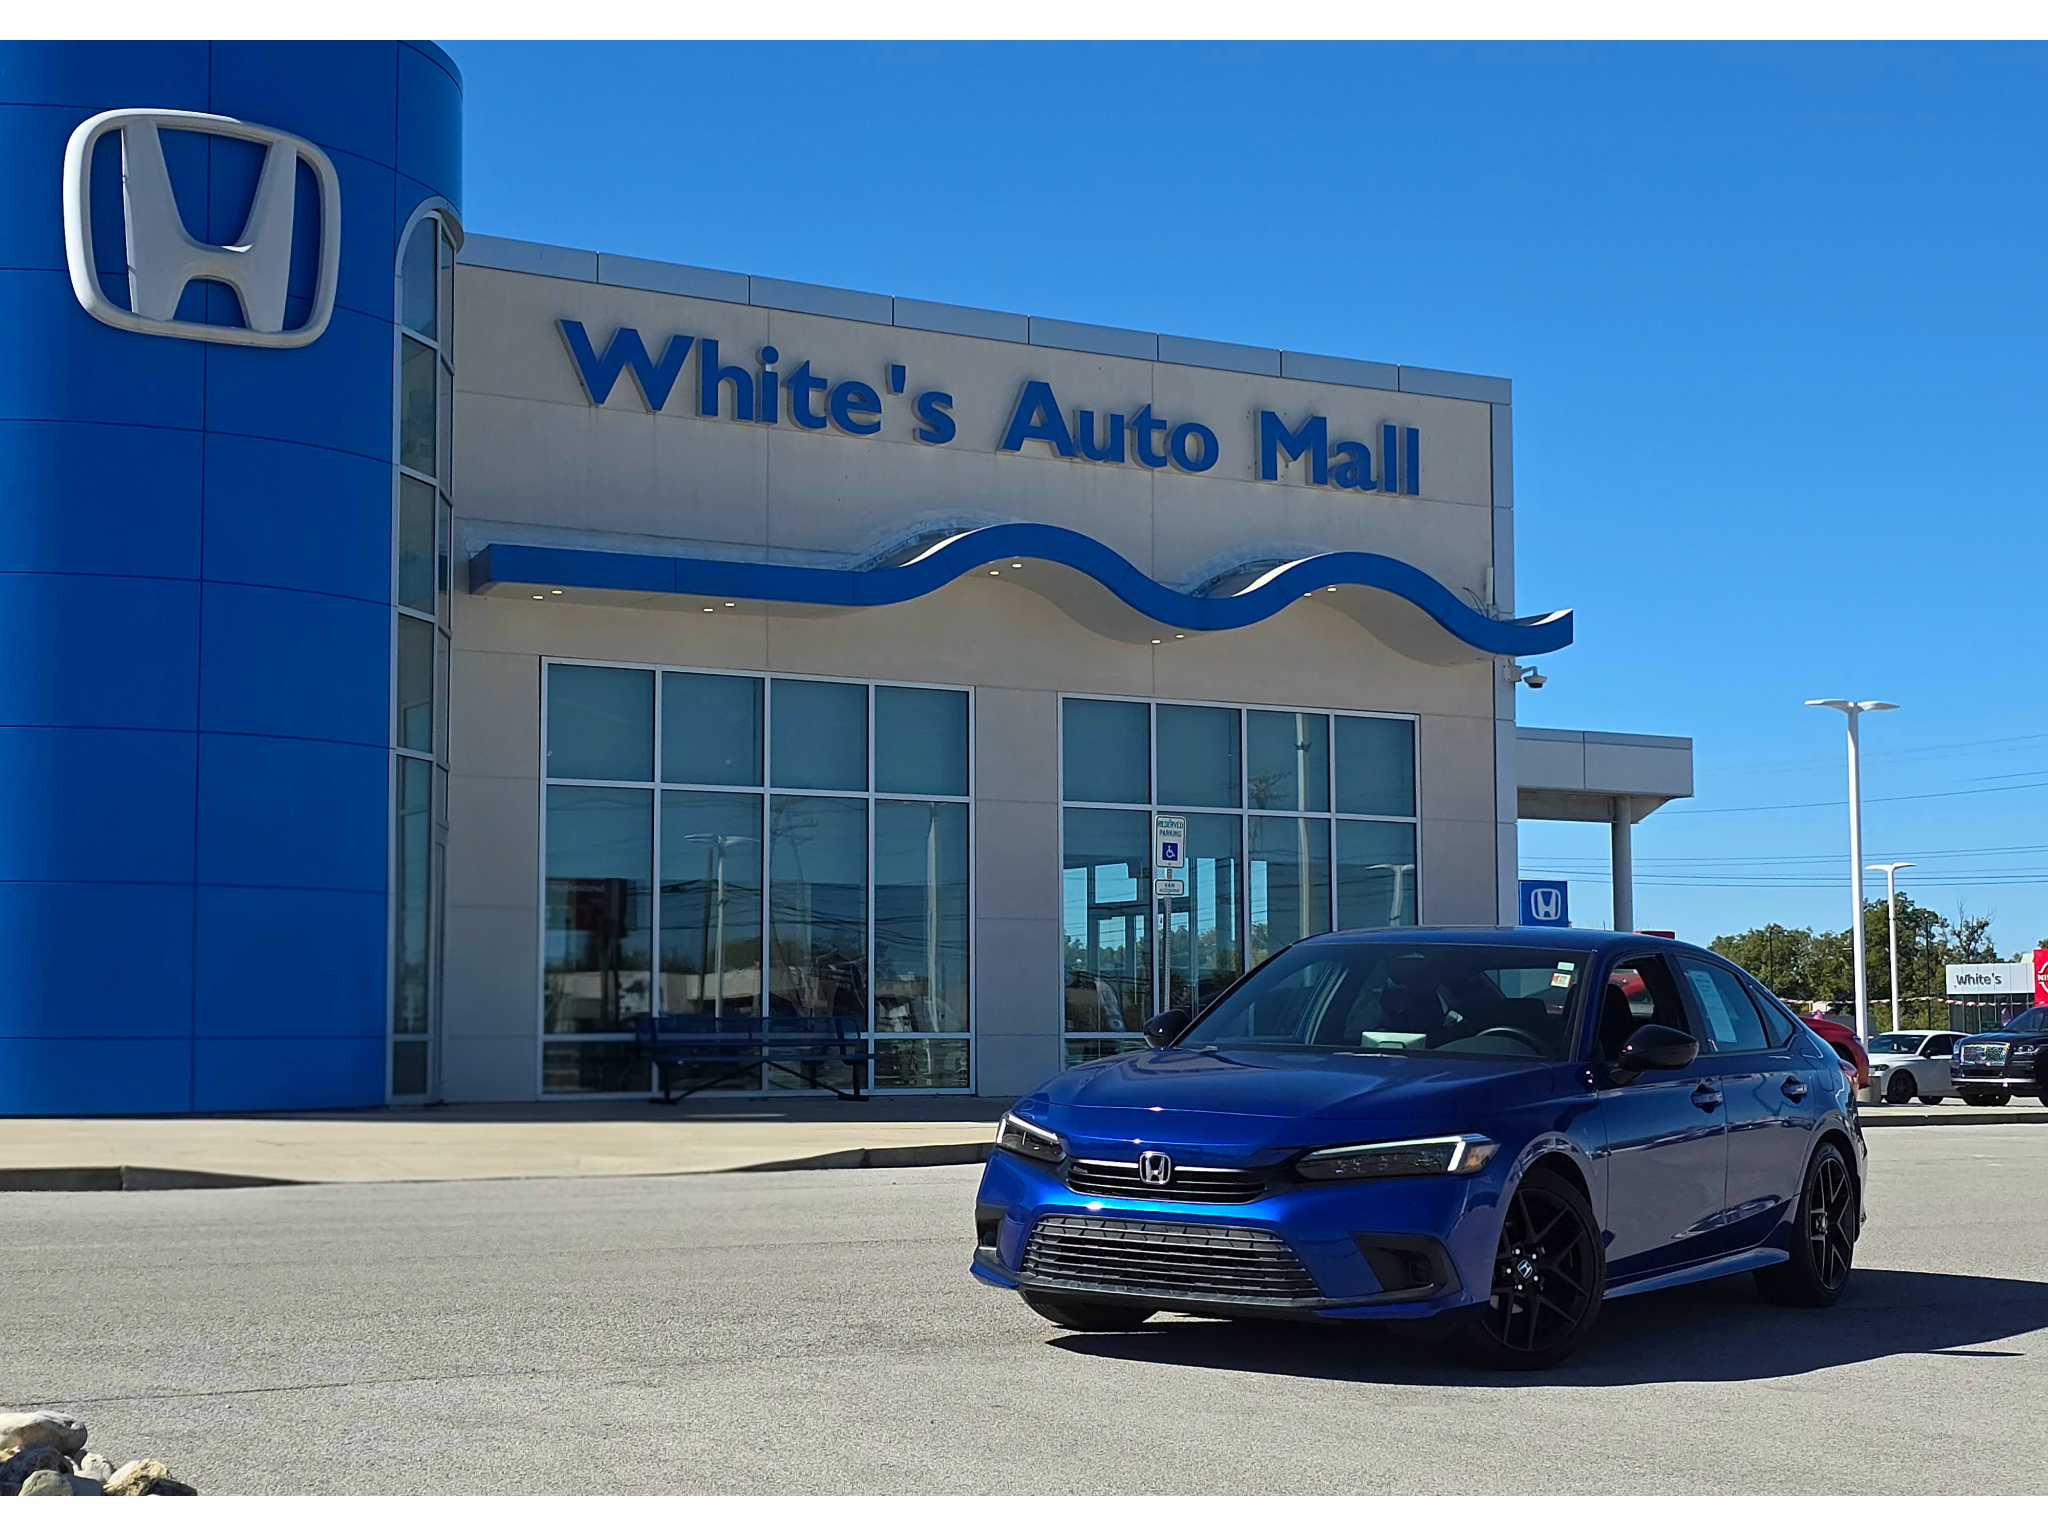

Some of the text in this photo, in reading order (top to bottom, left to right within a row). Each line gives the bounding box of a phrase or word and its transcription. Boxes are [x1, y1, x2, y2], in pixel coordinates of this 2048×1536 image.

[556, 319, 1420, 496] White's Auto Mall
[1158, 821, 1183, 829] RESERVED
[1159, 830, 1182, 838] PARKING
[1956, 973, 2002, 985] White's
